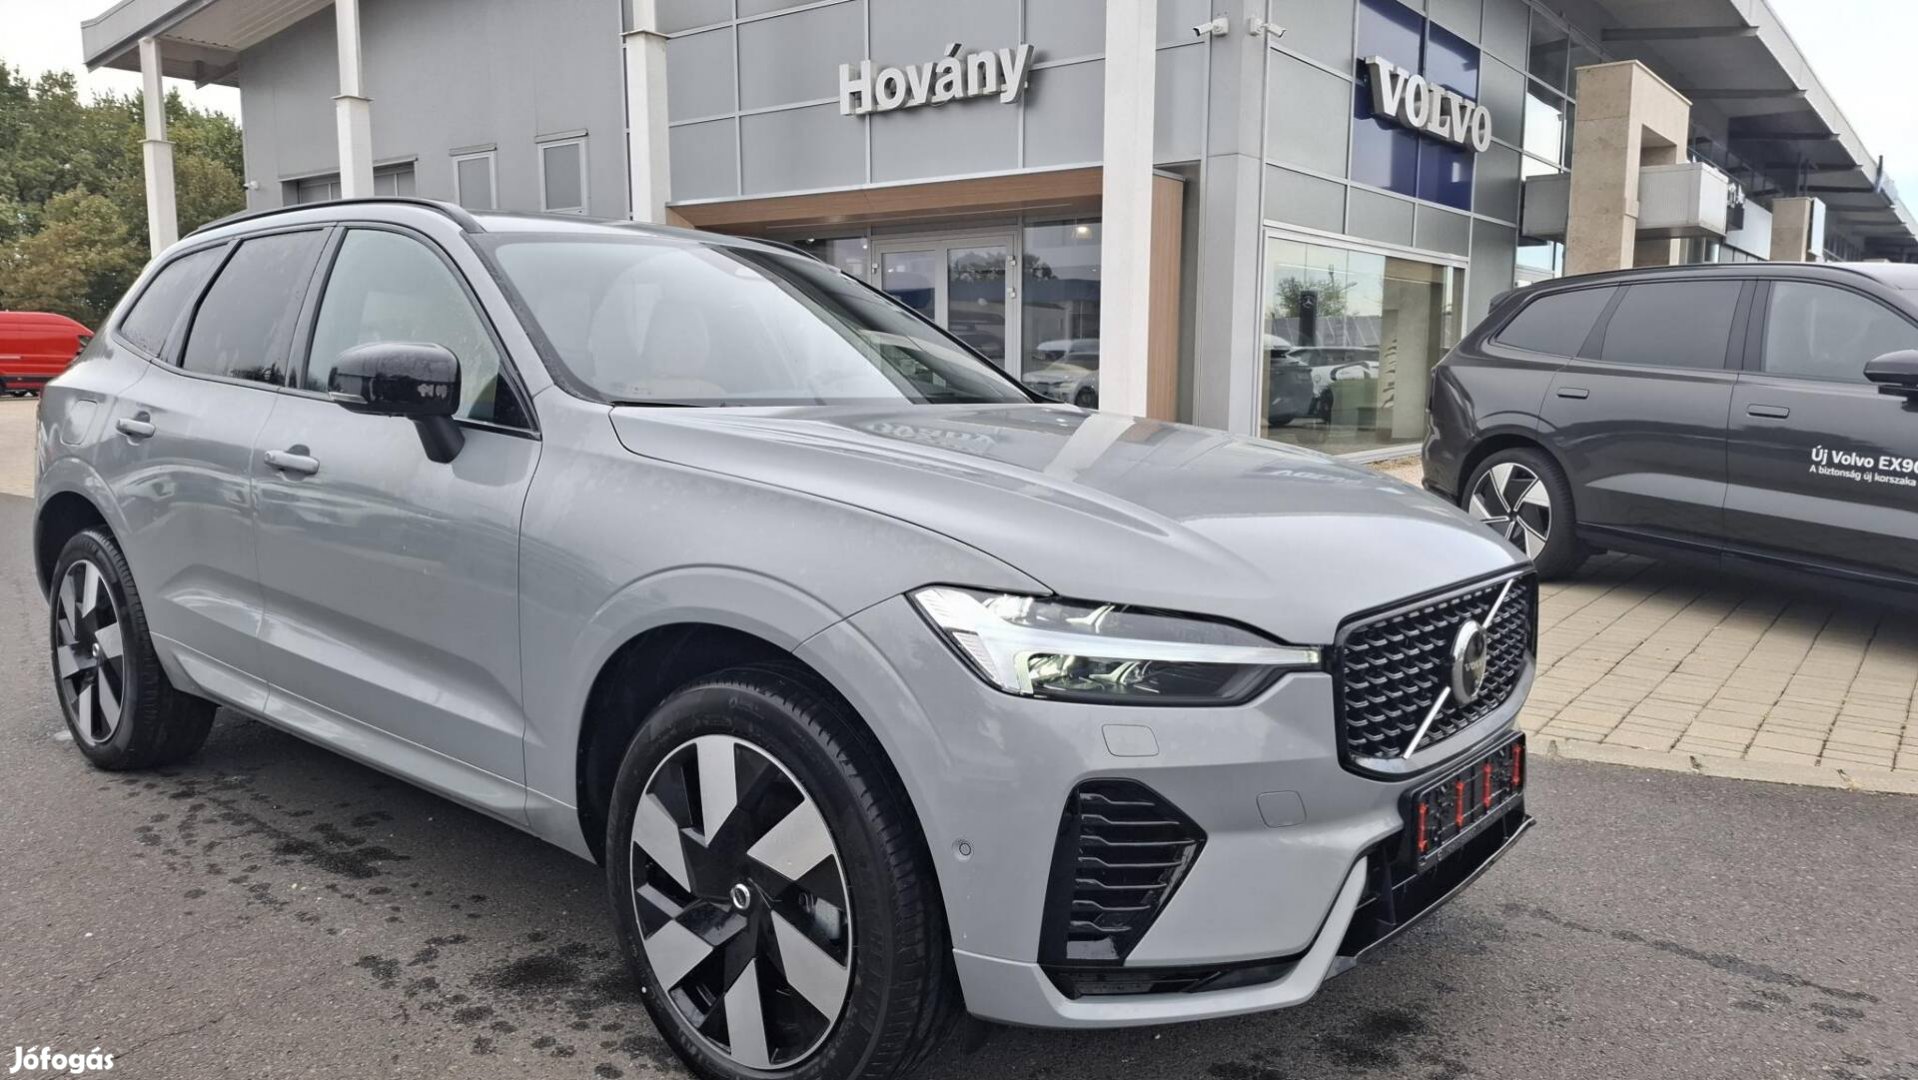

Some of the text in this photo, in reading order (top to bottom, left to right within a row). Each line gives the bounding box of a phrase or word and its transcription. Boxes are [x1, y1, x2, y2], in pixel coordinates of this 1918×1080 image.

[839, 43, 1033, 116] Hovány
[1366, 55, 1492, 152] VOLVO
[1809, 464, 1917, 487] A biztonság új korszaka
[1811, 445, 1828, 465] Új
[1831, 450, 1875, 468] Volvo
